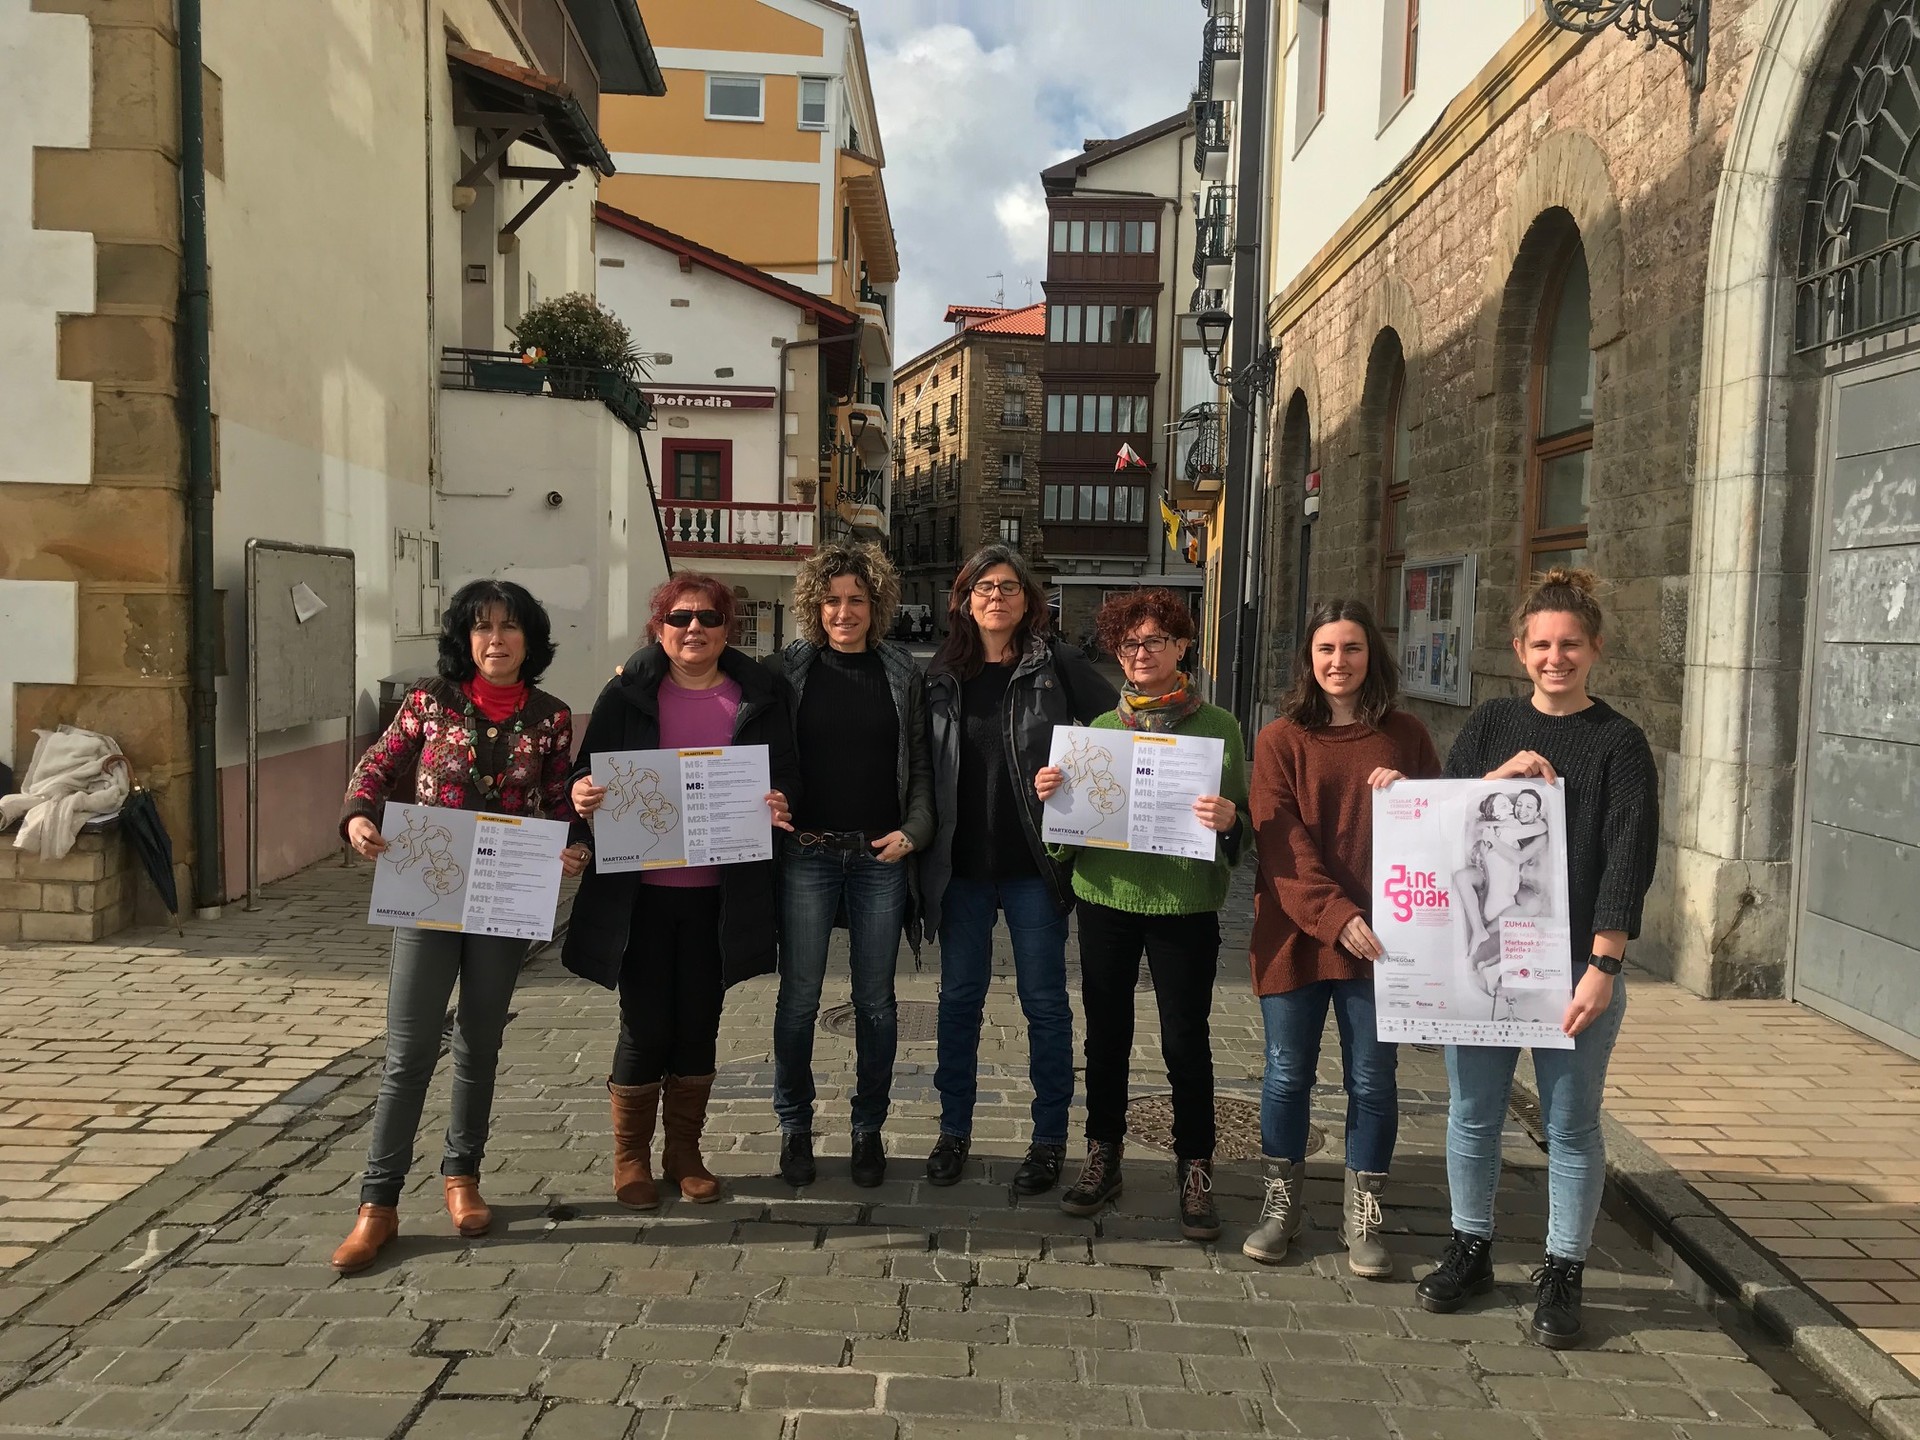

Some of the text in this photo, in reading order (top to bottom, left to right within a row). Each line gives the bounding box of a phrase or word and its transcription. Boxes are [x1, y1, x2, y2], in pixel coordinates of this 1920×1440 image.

[1136, 767, 1154, 775] M8:
[1136, 777, 1154, 786] M11:
[686, 782, 704, 790] M8:
[687, 792, 706, 800] M11:
[1135, 789, 1155, 797] M18:
[1414, 797, 1428, 808] 24
[687, 803, 708, 811] M18:
[1414, 808, 1421, 819] 8
[1133, 814, 1153, 822] M31:
[688, 828, 708, 836] M31:
[1049, 827, 1079, 835] MARTXOAK
[689, 839, 704, 847] A2:
[477, 848, 496, 856] M8:
[476, 858, 496, 866] M11:
[474, 869, 496, 878] M18:
[470, 894, 491, 903] M31:
[377, 908, 410, 916] MARTXOAK
[468, 906, 484, 914] A2:
